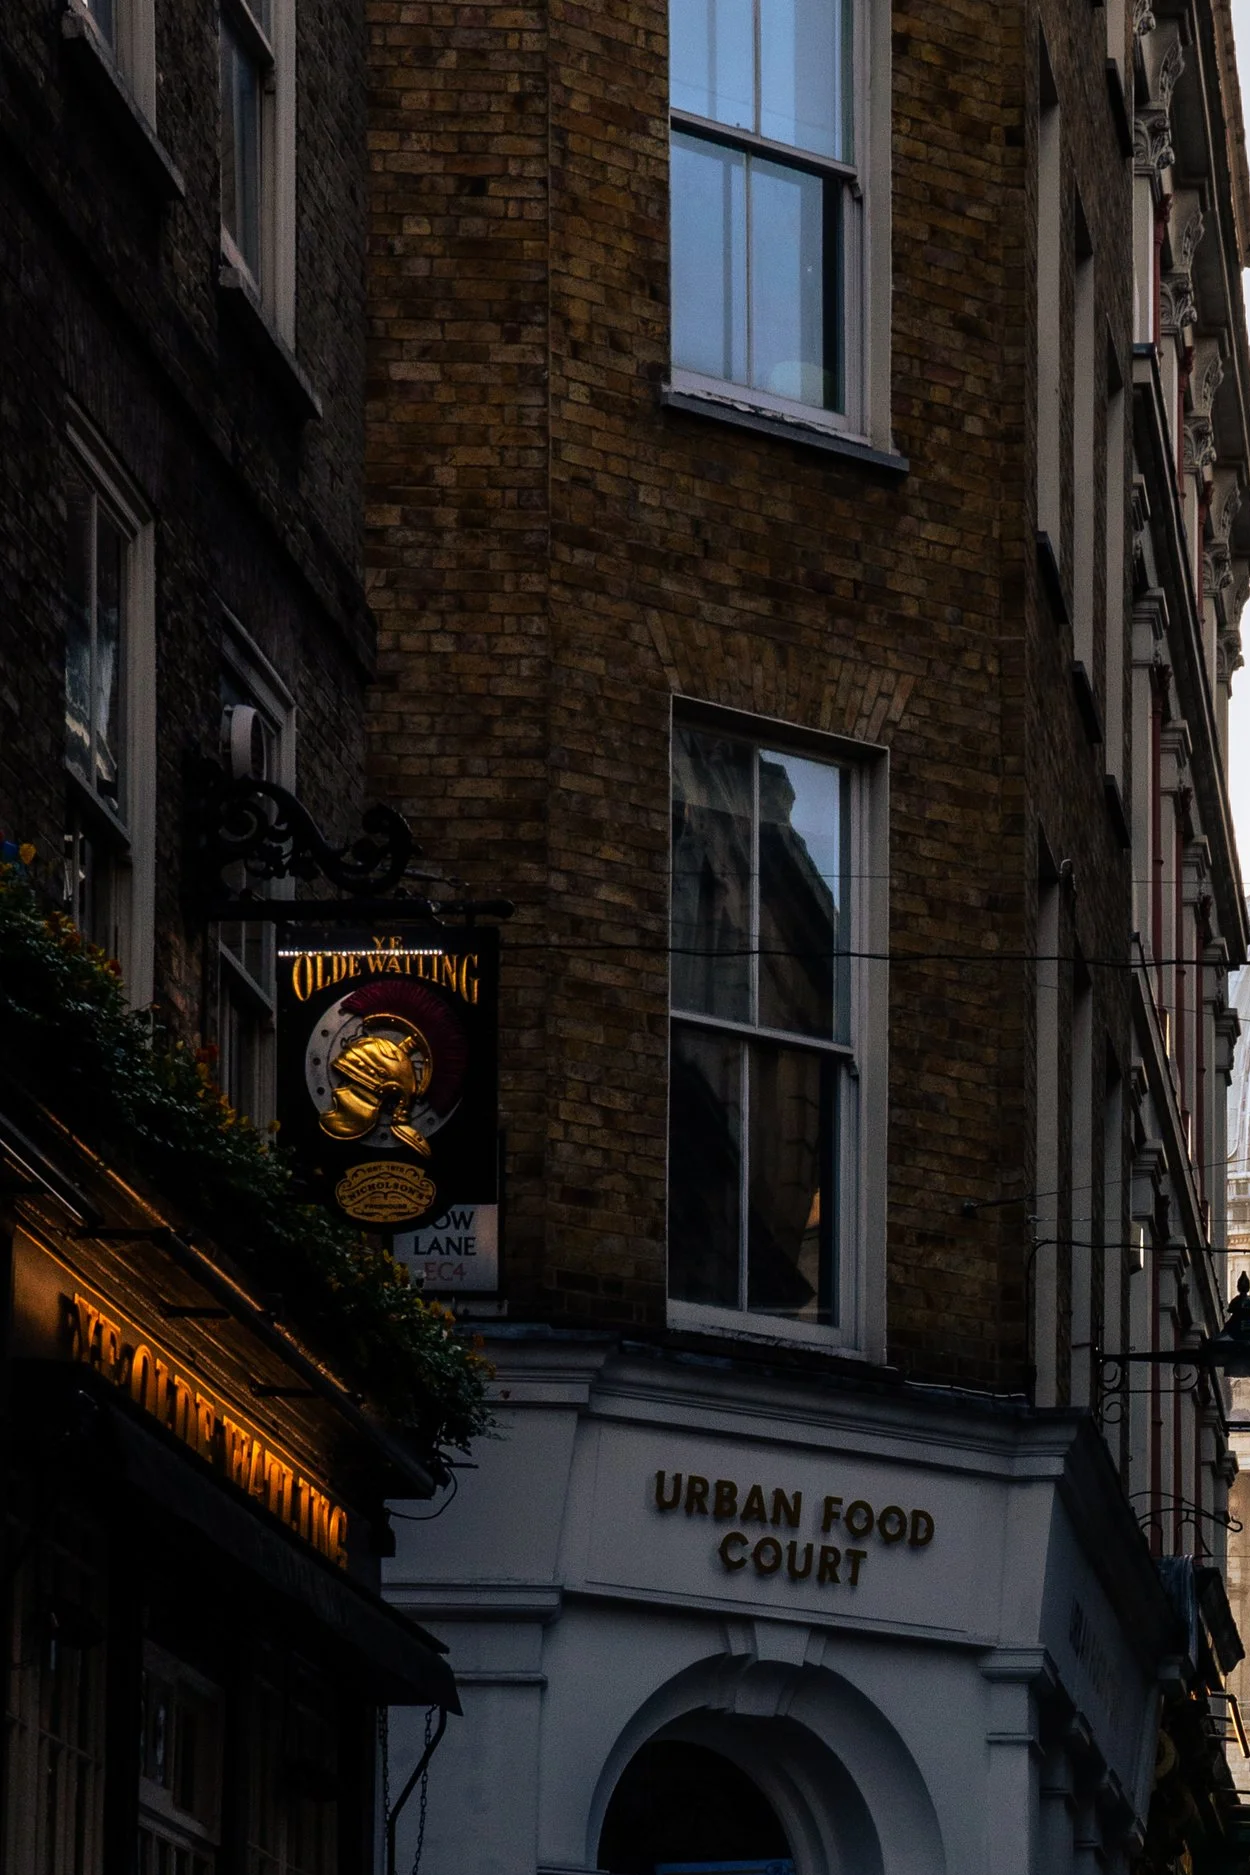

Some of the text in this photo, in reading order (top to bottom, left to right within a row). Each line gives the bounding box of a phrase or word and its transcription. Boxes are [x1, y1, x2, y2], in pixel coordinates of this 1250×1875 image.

[291, 951, 481, 1005] OLDE WATLING
[414, 1235, 477, 1256] LANE
[424, 1261, 467, 1282] EC4
[222, 1414, 349, 1573] WATLING
[655, 1470, 936, 1547] URBAN FOOD
[718, 1531, 868, 1587] COURT
